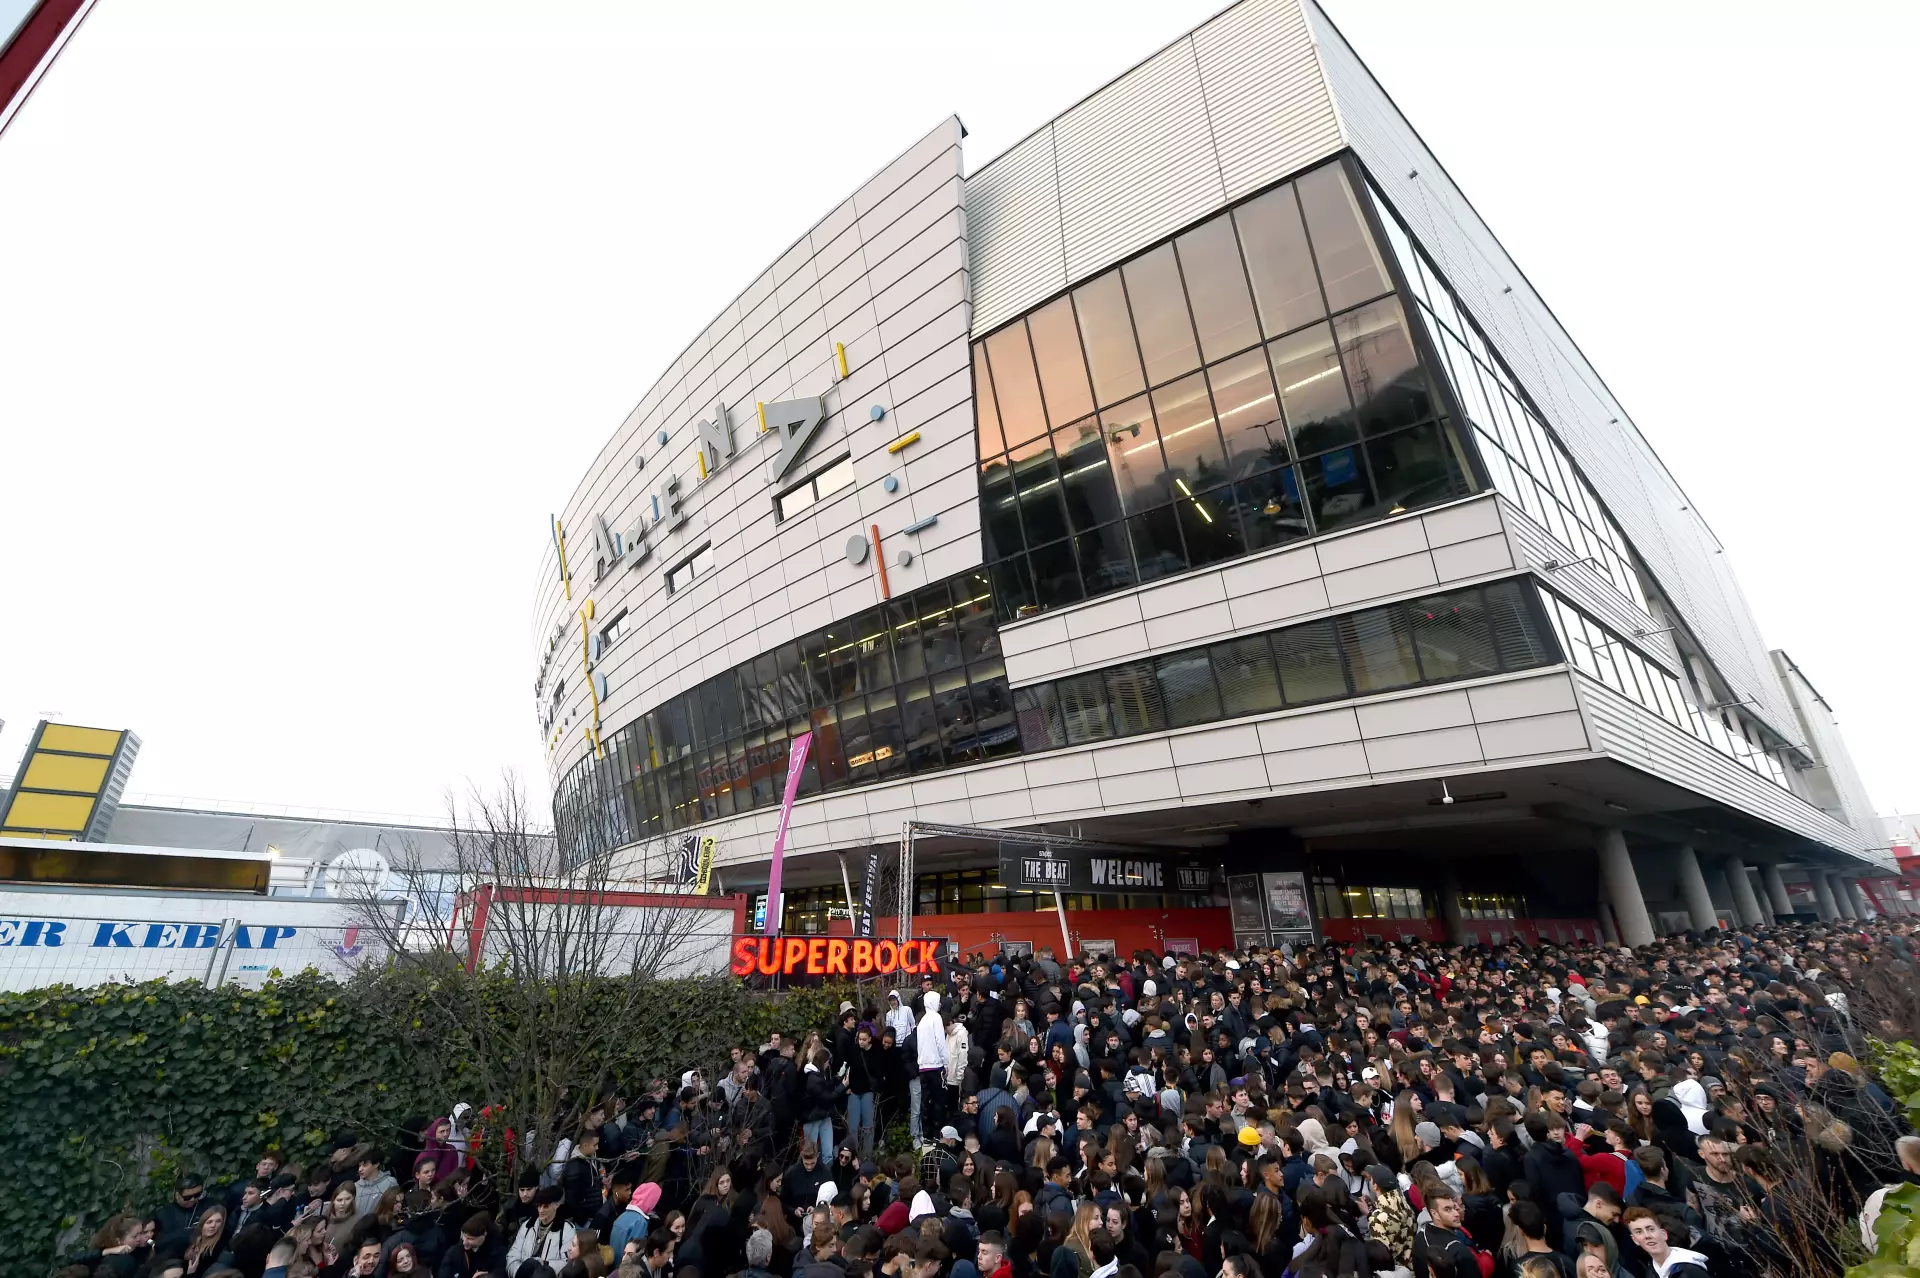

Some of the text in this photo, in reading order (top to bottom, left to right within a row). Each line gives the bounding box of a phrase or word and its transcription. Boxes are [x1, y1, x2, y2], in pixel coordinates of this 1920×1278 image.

[590, 396, 826, 582] ARENA
[865, 854, 878, 908] FESTIVAL
[1025, 861, 1067, 880] THE BEAT
[1090, 858, 1164, 887] WELCOME
[89, 923, 297, 949] KEBAP
